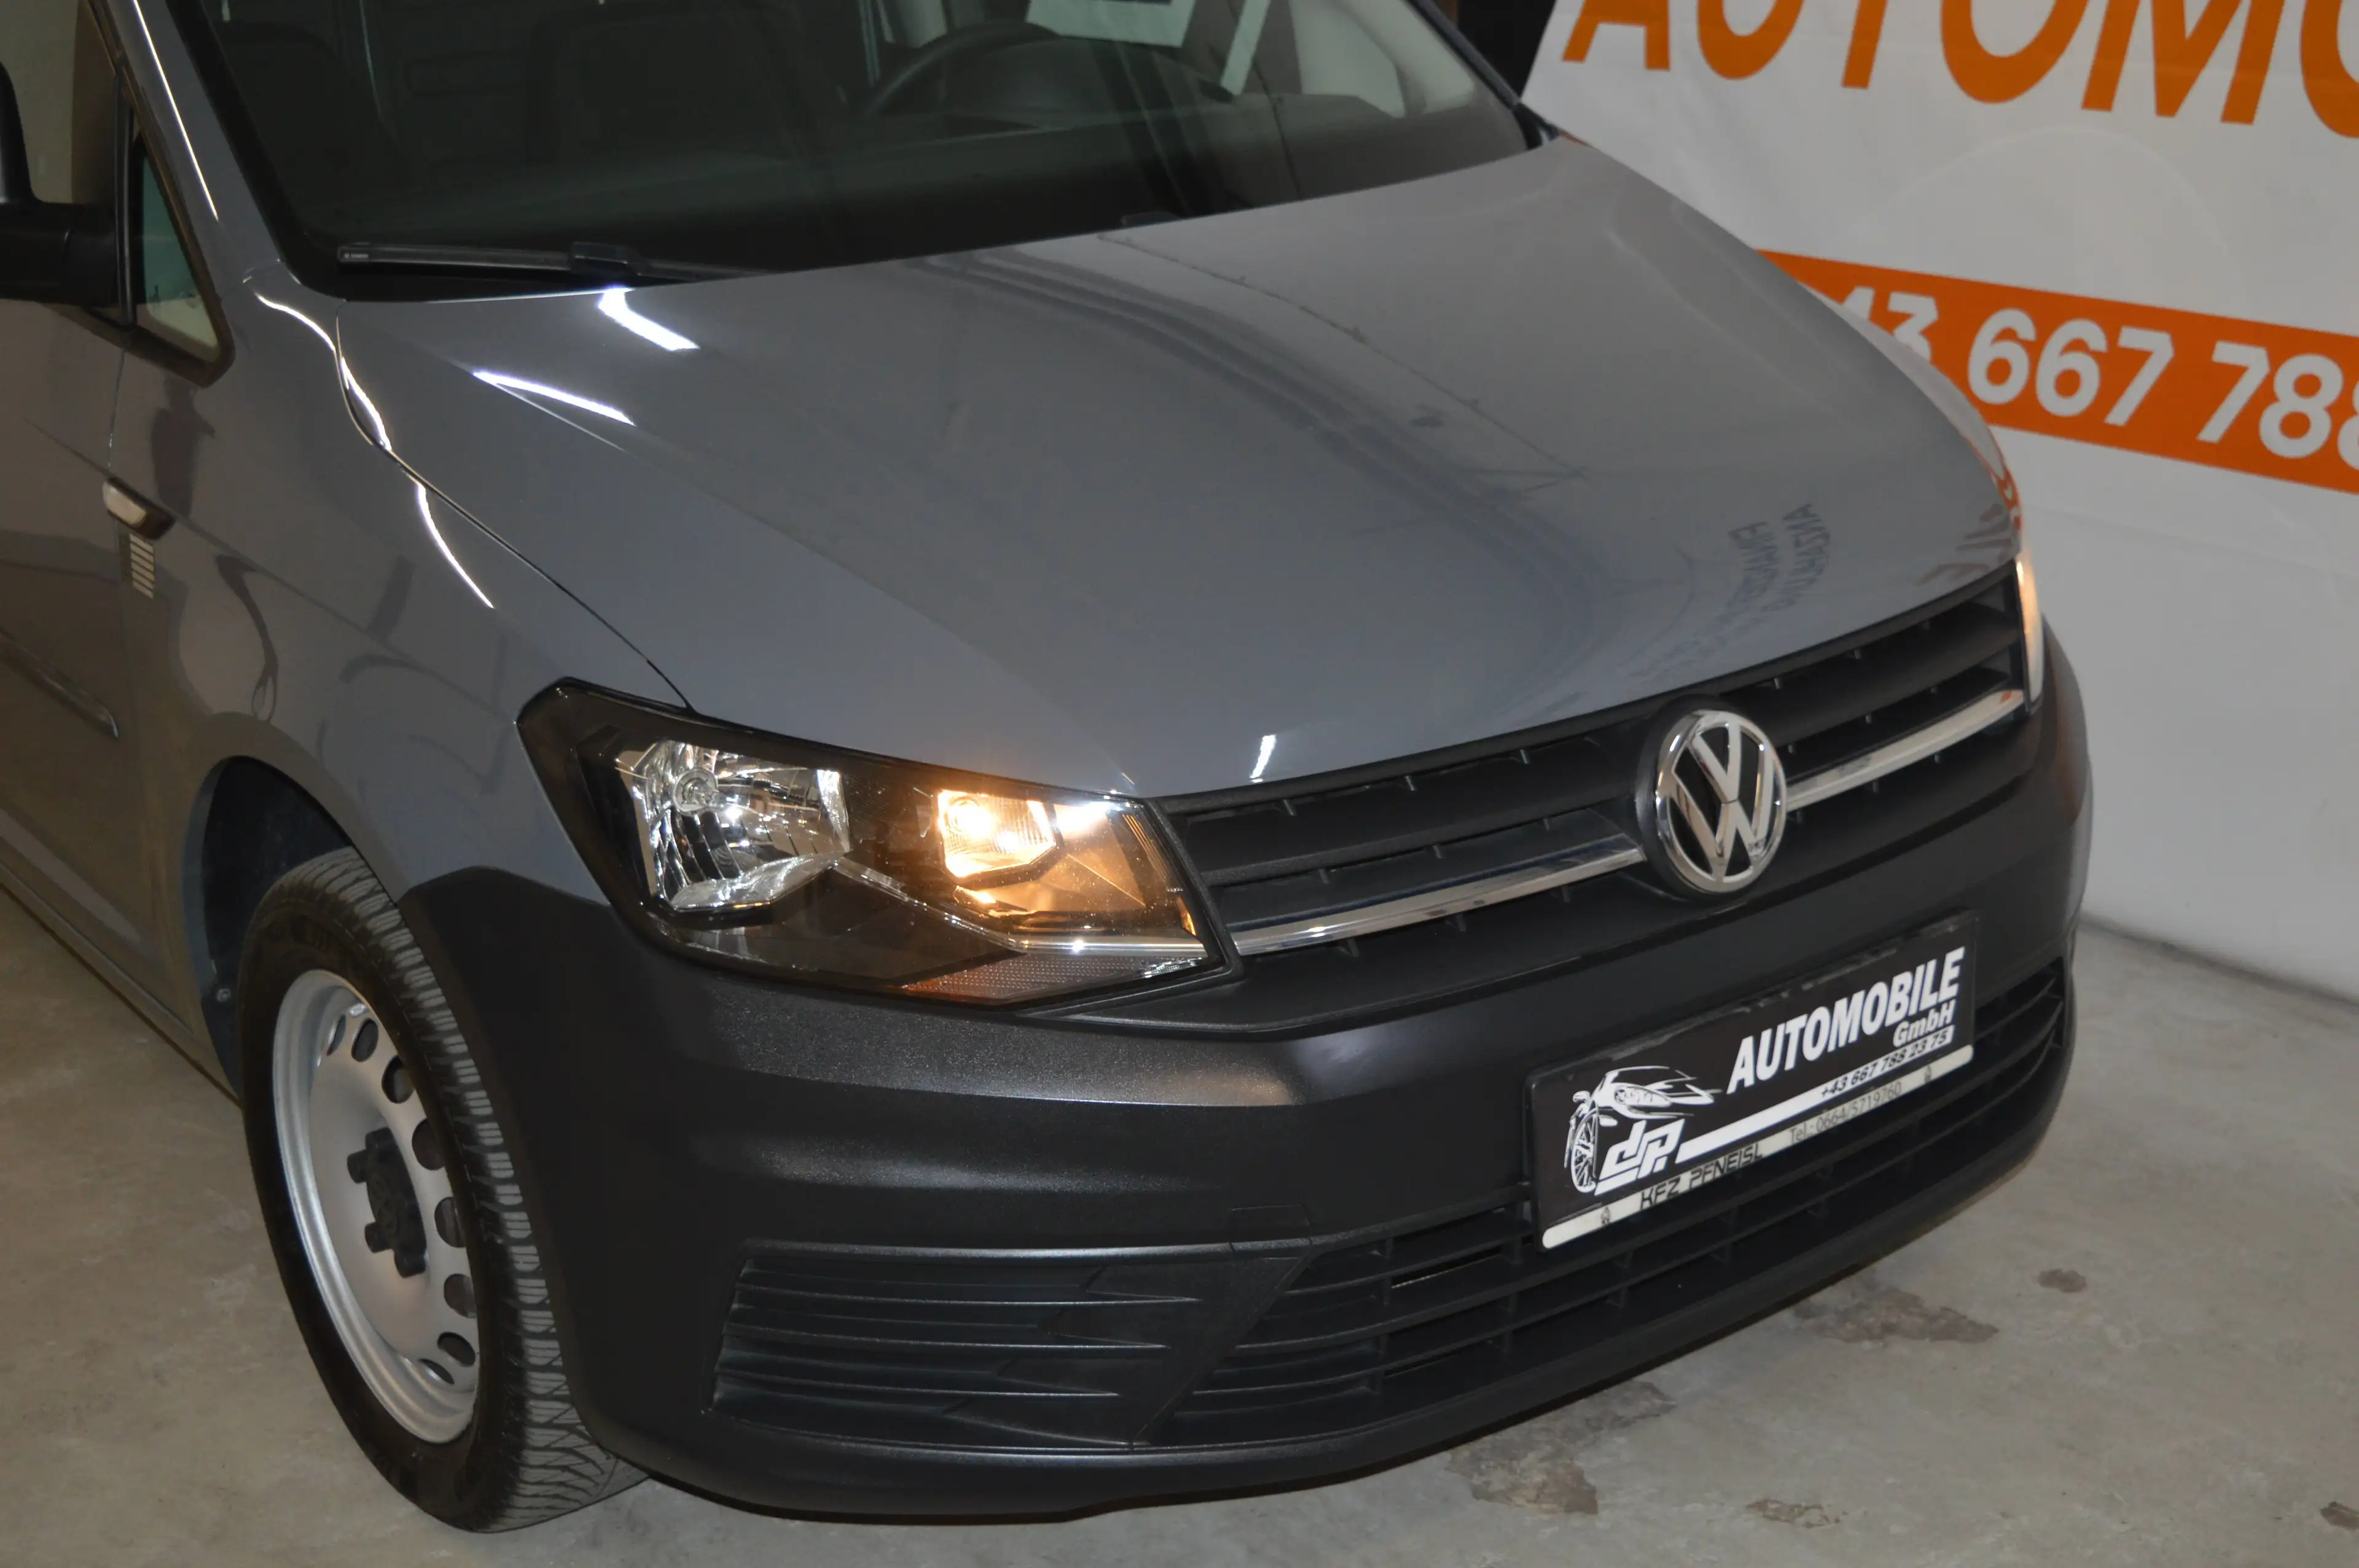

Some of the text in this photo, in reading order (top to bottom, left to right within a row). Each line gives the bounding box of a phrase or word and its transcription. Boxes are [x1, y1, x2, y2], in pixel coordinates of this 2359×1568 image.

[1968, 308, 2174, 426] 667
[2197, 340, 2359, 472] 78
[1726, 946, 1965, 1094] AUTOMOBILE
[1821, 1031, 1948, 1097] +43 667 788 23 75
[1893, 999, 1955, 1047] GmbH
[1640, 1176, 1681, 1210] KFZ
[1689, 1143, 1763, 1190] PFNEISL
[1816, 1081, 1902, 1133] 0664/5719760
